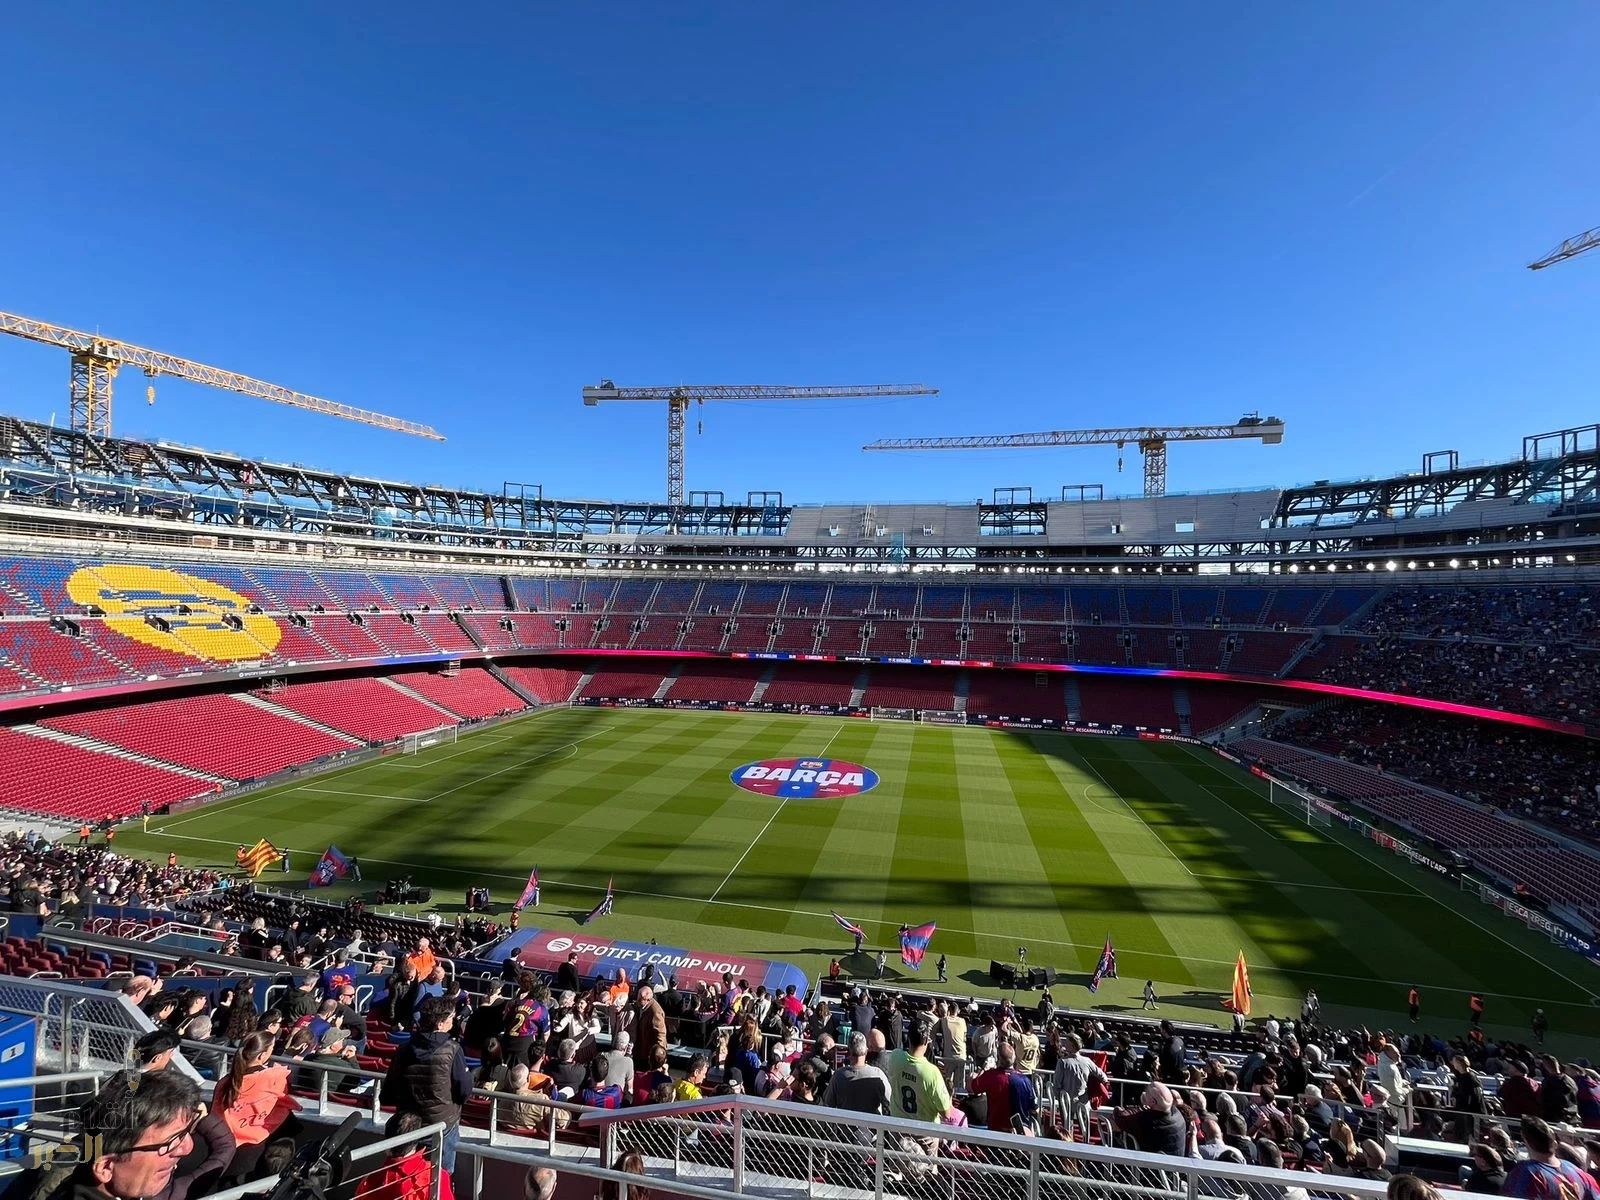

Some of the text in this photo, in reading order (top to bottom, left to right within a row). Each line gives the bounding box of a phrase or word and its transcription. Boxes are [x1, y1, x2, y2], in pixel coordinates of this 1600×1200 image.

[741, 766, 864, 786] BARÇA
[203, 785, 250, 803] DESCARREGA'T
[1430, 861, 1447, 874] L'APP
[572, 942, 746, 976] SPOTIFY CAMP NOU
[1022, 1049, 1035, 1061] 10
[902, 1071, 917, 1082] PEDRI
[902, 1086, 917, 1114] 8
